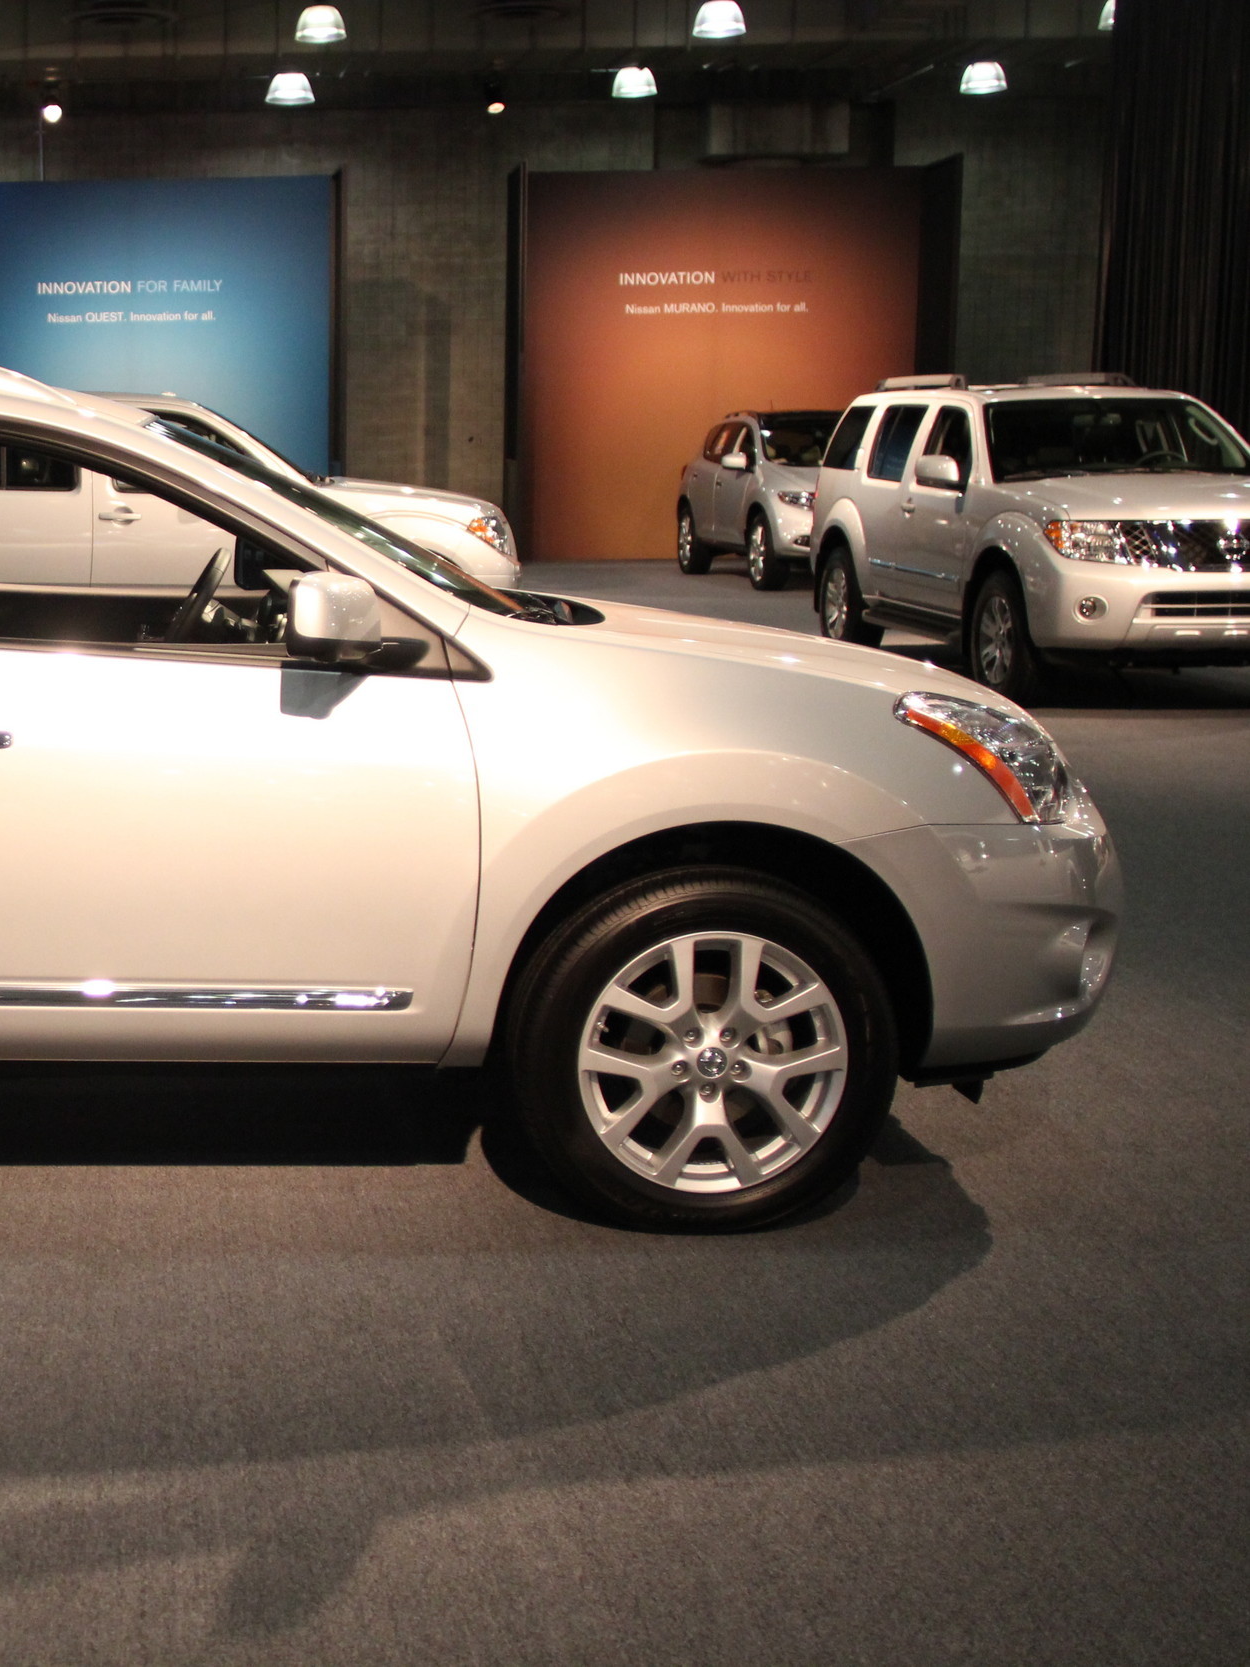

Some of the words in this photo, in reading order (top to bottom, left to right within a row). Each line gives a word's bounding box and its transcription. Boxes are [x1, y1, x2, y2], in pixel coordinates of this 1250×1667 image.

[620, 271, 715, 286] INNOVATION
[722, 271, 760, 284] WITH
[767, 270, 813, 284] STYLE
[37, 280, 132, 295] INNOVATION
[137, 280, 167, 293] FOR
[173, 279, 223, 293] FAMILY
[625, 303, 661, 315] Nissan
[664, 302, 718, 314] MURANO.
[722, 302, 773, 313] Innovation
[776, 302, 791, 313] for
[794, 302, 809, 313] all.
[47, 312, 82, 323] Nissan
[85, 311, 126, 323] QUEST.
[130, 311, 181, 322] Innovation
[184, 311, 199, 321] for
[201, 310, 216, 321] all.
